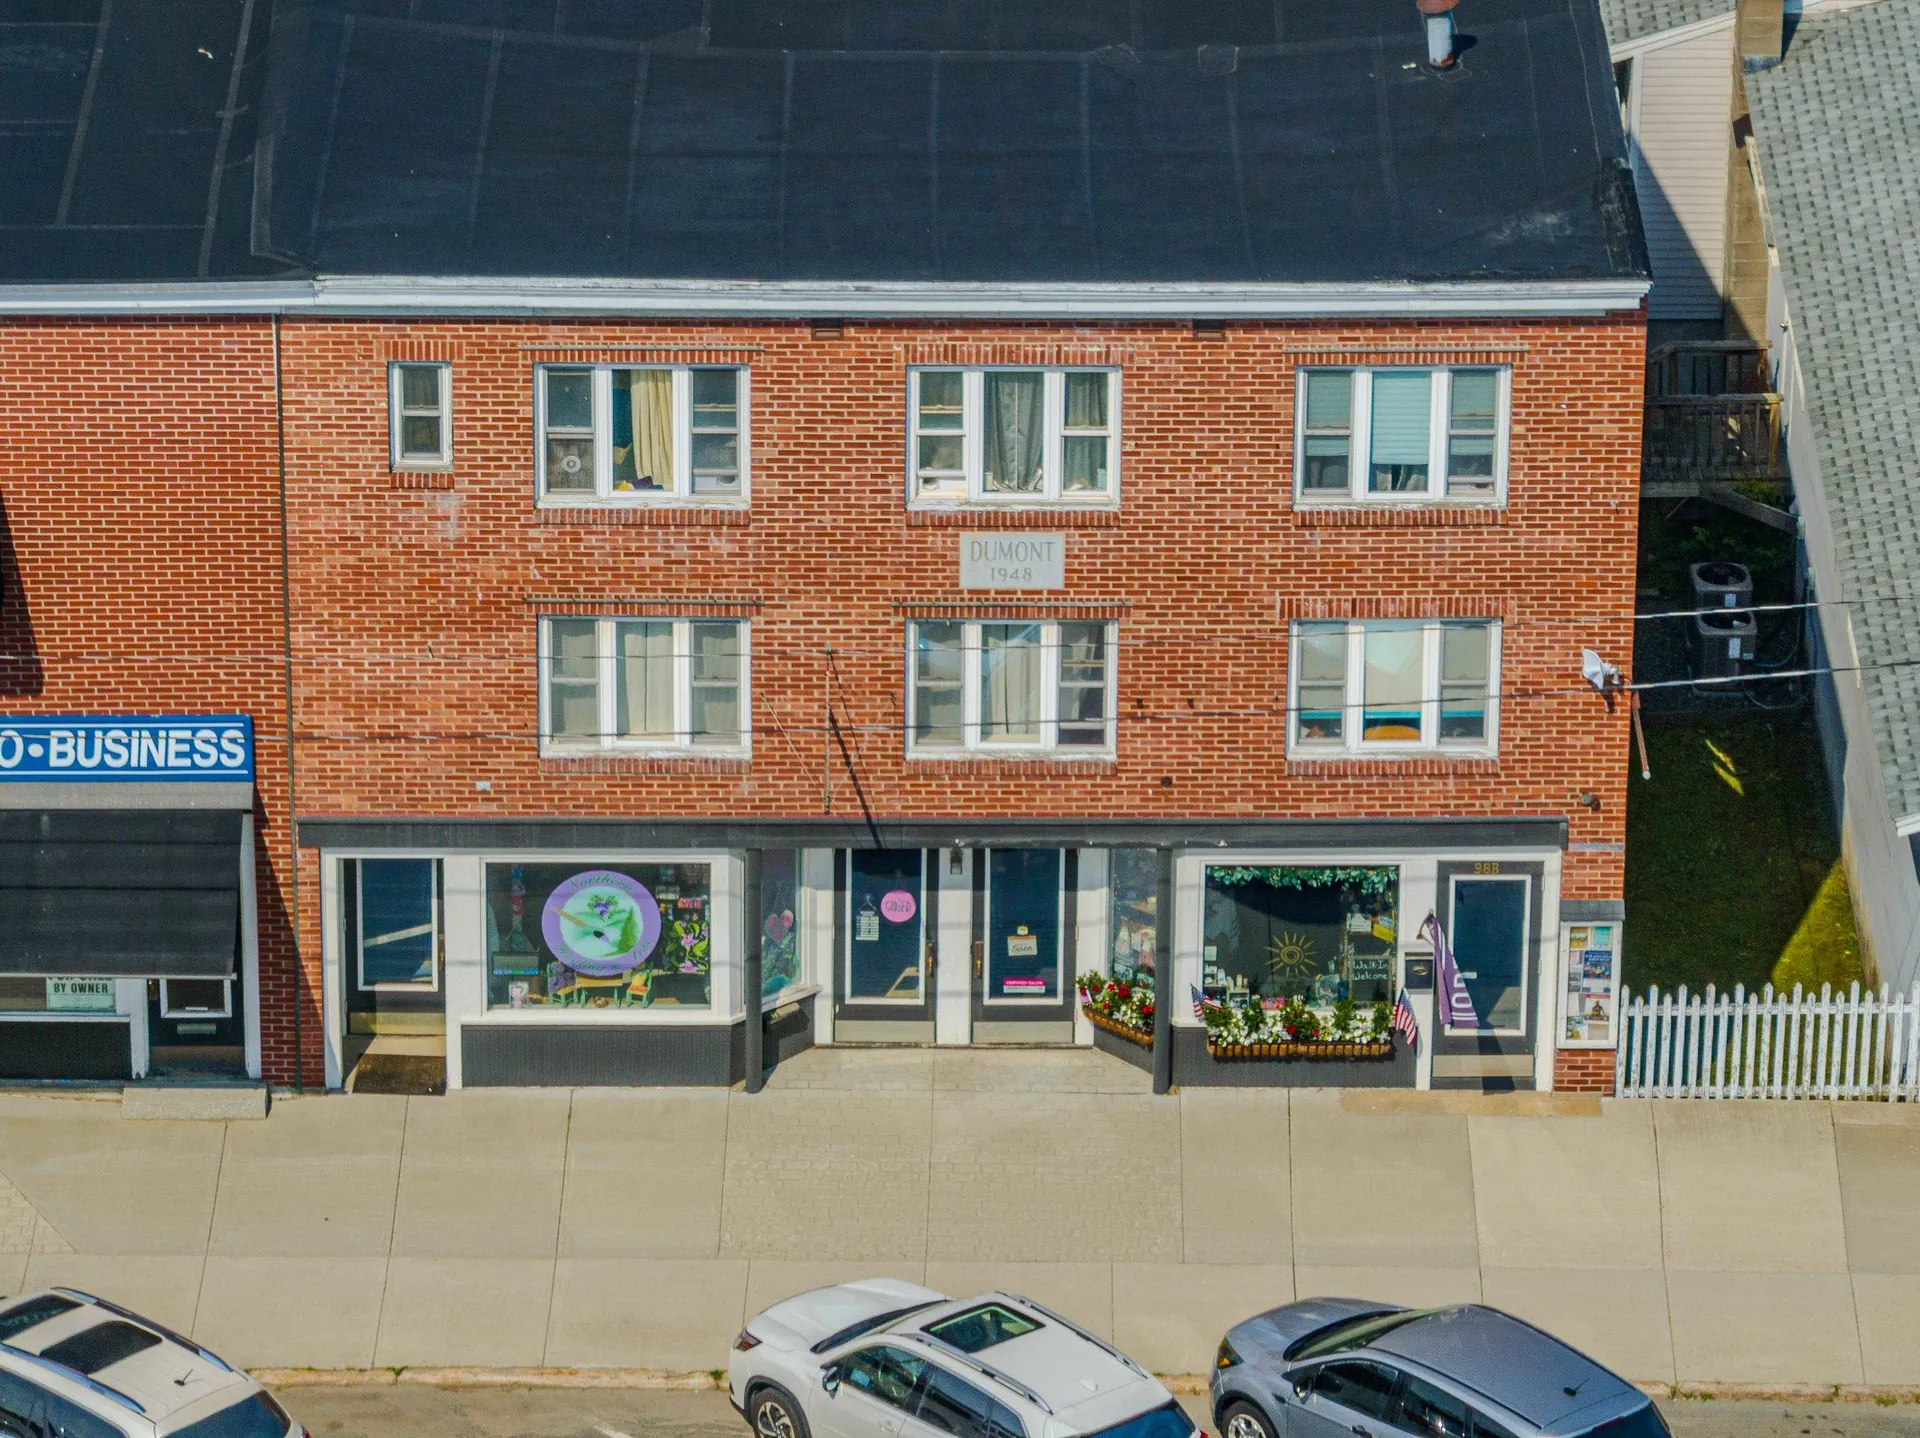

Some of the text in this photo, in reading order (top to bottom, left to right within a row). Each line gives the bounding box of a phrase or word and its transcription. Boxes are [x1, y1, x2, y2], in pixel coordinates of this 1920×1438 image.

[970, 540, 1056, 563] DUMONT
[990, 567, 1033, 583] 1948
[49, 729, 246, 768] BUSINESS
[1011, 944, 1034, 954] Open
[53, 982, 109, 994] BY OWNER
